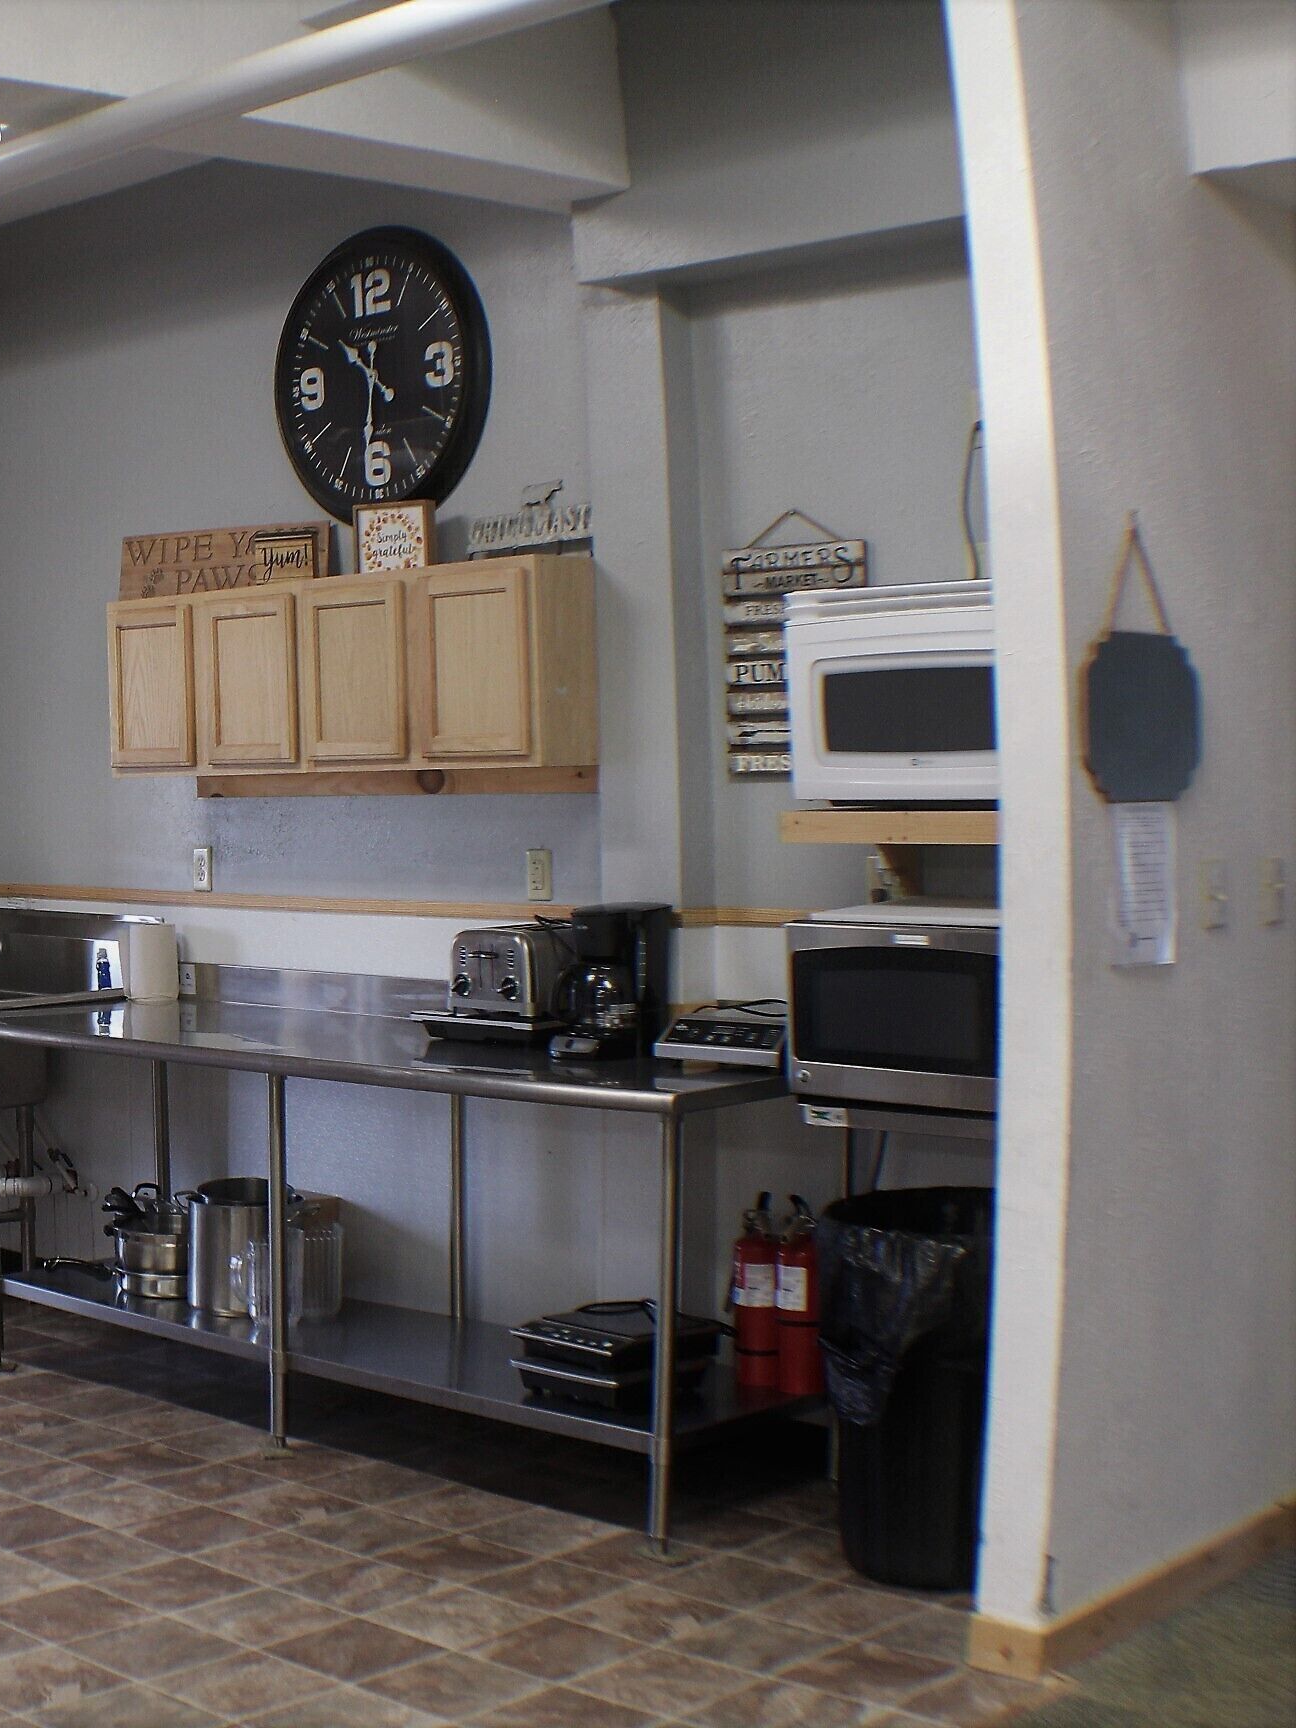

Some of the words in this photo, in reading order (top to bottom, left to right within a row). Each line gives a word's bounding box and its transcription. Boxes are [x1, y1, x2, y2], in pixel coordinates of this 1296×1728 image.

[350, 267, 391, 318] 12
[424, 340, 455, 388] 3
[301, 367, 324, 411] 9
[365, 440, 392, 486] 6
[125, 534, 213, 567] WIPE
[377, 530, 407, 544] Simply
[372, 544, 413, 559] grateful
[730, 546, 855, 590] FARMERS
[765, 573, 818, 589] MARKET
[745, 603, 784, 617] FRES
[735, 662, 785, 683] PUM
[736, 755, 792, 772] FRES
